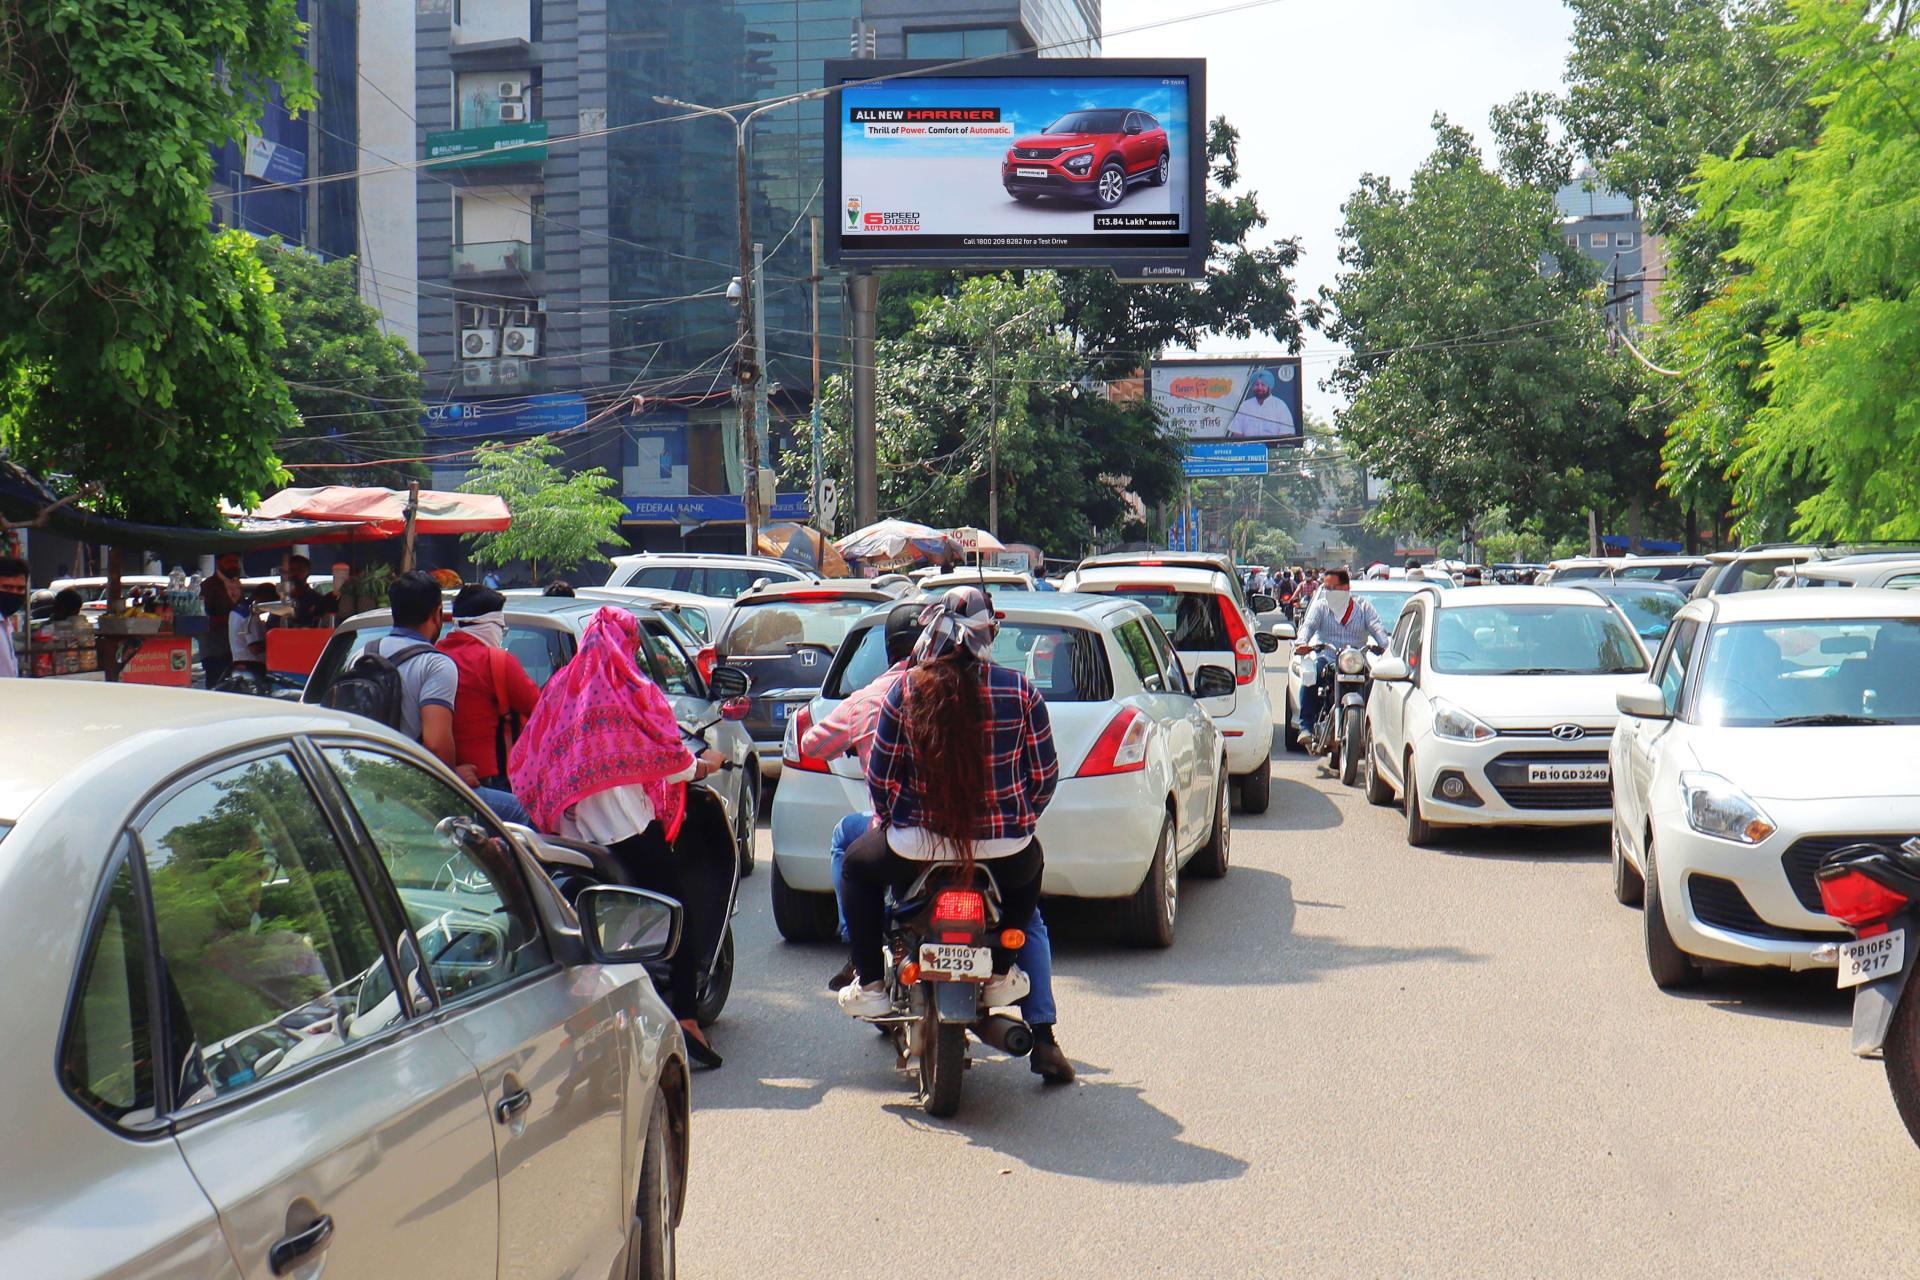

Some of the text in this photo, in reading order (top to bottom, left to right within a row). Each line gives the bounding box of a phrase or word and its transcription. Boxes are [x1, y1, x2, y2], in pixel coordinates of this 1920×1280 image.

[856, 110, 995, 120] ALL NEW HARRIER
[868, 126, 1011, 135] Thrill of Power. Comfort of Automatic.
[863, 212, 884, 225] 6
[1148, 218, 1176, 226] onwards
[1148, 266, 1185, 277] LeafBerry
[636, 503, 674, 513] FEDERAL
[937, 946, 977, 959] PB10GY
[1850, 938, 1892, 959] PB10FS
[934, 957, 974, 971] 1239
[1851, 953, 1890, 975] 9217
